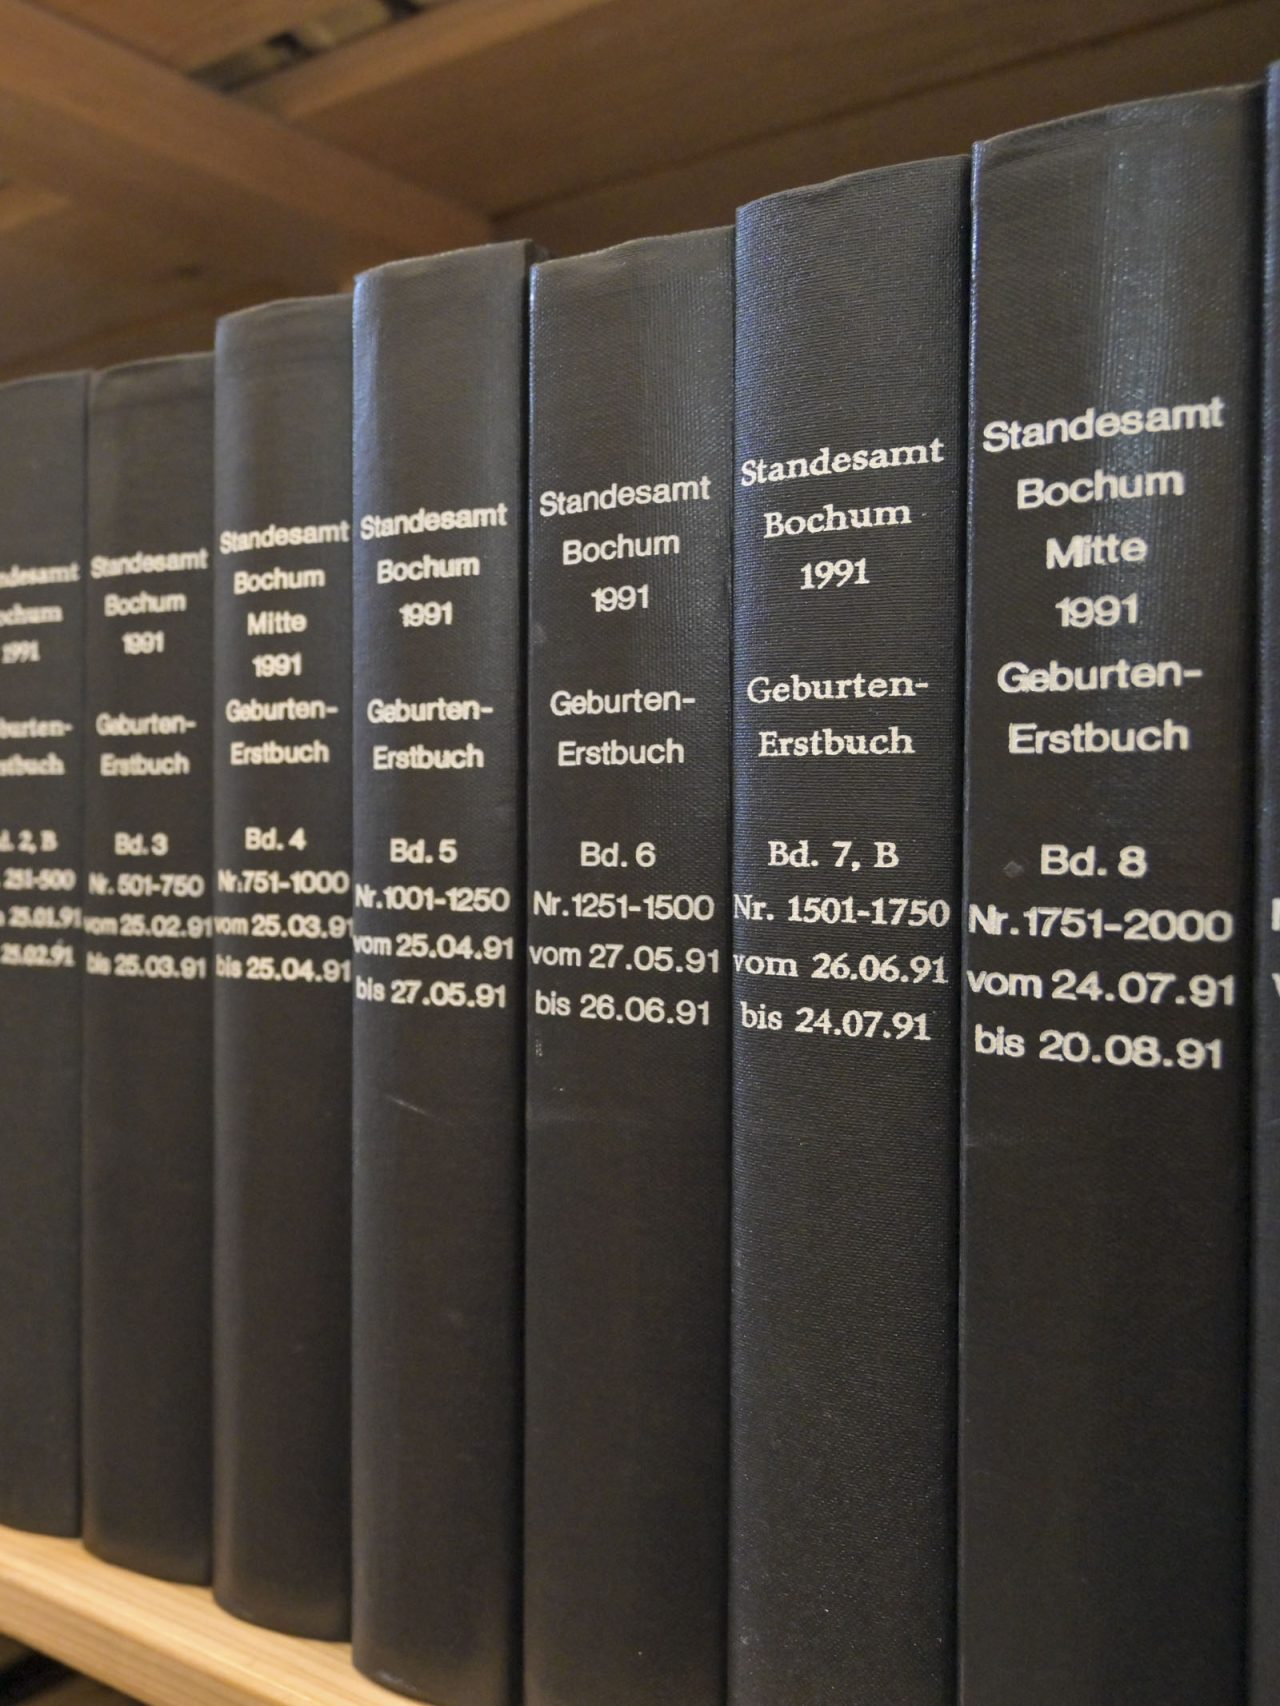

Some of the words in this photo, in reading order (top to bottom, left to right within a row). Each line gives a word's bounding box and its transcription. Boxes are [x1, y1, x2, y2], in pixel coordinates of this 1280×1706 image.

[982, 397, 1225, 453] Standesamt
[740, 437, 945, 487] Standesamt
[539, 475, 712, 518] Standesamt
[1016, 466, 1186, 510] Bochum
[218, 519, 351, 556] Standesamt
[359, 502, 509, 541] Standesamt
[762, 503, 913, 540] Bochum
[90, 547, 209, 580] Standesamt
[562, 532, 681, 566] Bochum
[1045, 533, 1149, 570] Mitte
[233, 566, 326, 596] Bochum
[376, 554, 481, 585] Bochum
[800, 557, 871, 591] 1991
[104, 590, 187, 617] Bochum
[398, 600, 453, 628] 1991
[590, 583, 649, 613] 1991
[1054, 591, 1139, 629] 1991
[247, 610, 308, 636] Mitte
[121, 630, 165, 655] 1991
[251, 652, 302, 678] 1991
[996, 658, 1203, 694] Geburten-
[549, 688, 696, 717] Geburten-
[747, 672, 929, 705] Geburten-
[95, 712, 197, 737] Geburten-
[225, 697, 339, 724] Geburten-
[366, 697, 494, 724] Geburten-
[229, 739, 330, 766] Erstbuch
[557, 737, 685, 767] Erstbuch
[757, 725, 916, 758] Erstbuch
[1008, 718, 1190, 755] Erstbuch
[99, 751, 190, 777] Erstbuch
[372, 742, 485, 771] Erstbuch
[580, 840, 628, 868] Bd.
[635, 841, 657, 868] 6
[767, 839, 819, 868] Bd.
[831, 840, 862, 872] 7,
[873, 841, 900, 869] B
[1040, 843, 1108, 877] Bd.
[1117, 845, 1148, 879] 8
[82, 916, 119, 936] vom
[119, 912, 214, 939] 25.02.91
[733, 893, 775, 921] Nr.
[787, 895, 951, 928] 1501-1750
[214, 915, 249, 936] vom
[251, 913, 355, 942] 25.03.91
[351, 933, 393, 956] vom
[395, 932, 514, 961] 25.04.91
[528, 945, 582, 967] vom
[588, 943, 719, 974] 27.05.91
[86, 951, 112, 976] bis
[114, 952, 207, 980] 25.03.91
[215, 953, 243, 979] bis
[245, 955, 352, 983] 25.04.91
[732, 953, 799, 978] vom
[810, 952, 949, 984] 26.06.91
[355, 974, 386, 1002] bis
[390, 979, 506, 1009] 27.05.91
[965, 969, 1043, 999] vom
[1051, 968, 1235, 1008] 24.07.91
[535, 989, 572, 1017] bis
[579, 993, 710, 1026] 26.06.91
[739, 1000, 783, 1031] bis
[794, 1006, 932, 1041] 24.07.91
[974, 1023, 1026, 1058] bis
[1038, 1029, 1222, 1070] 20.08.91
